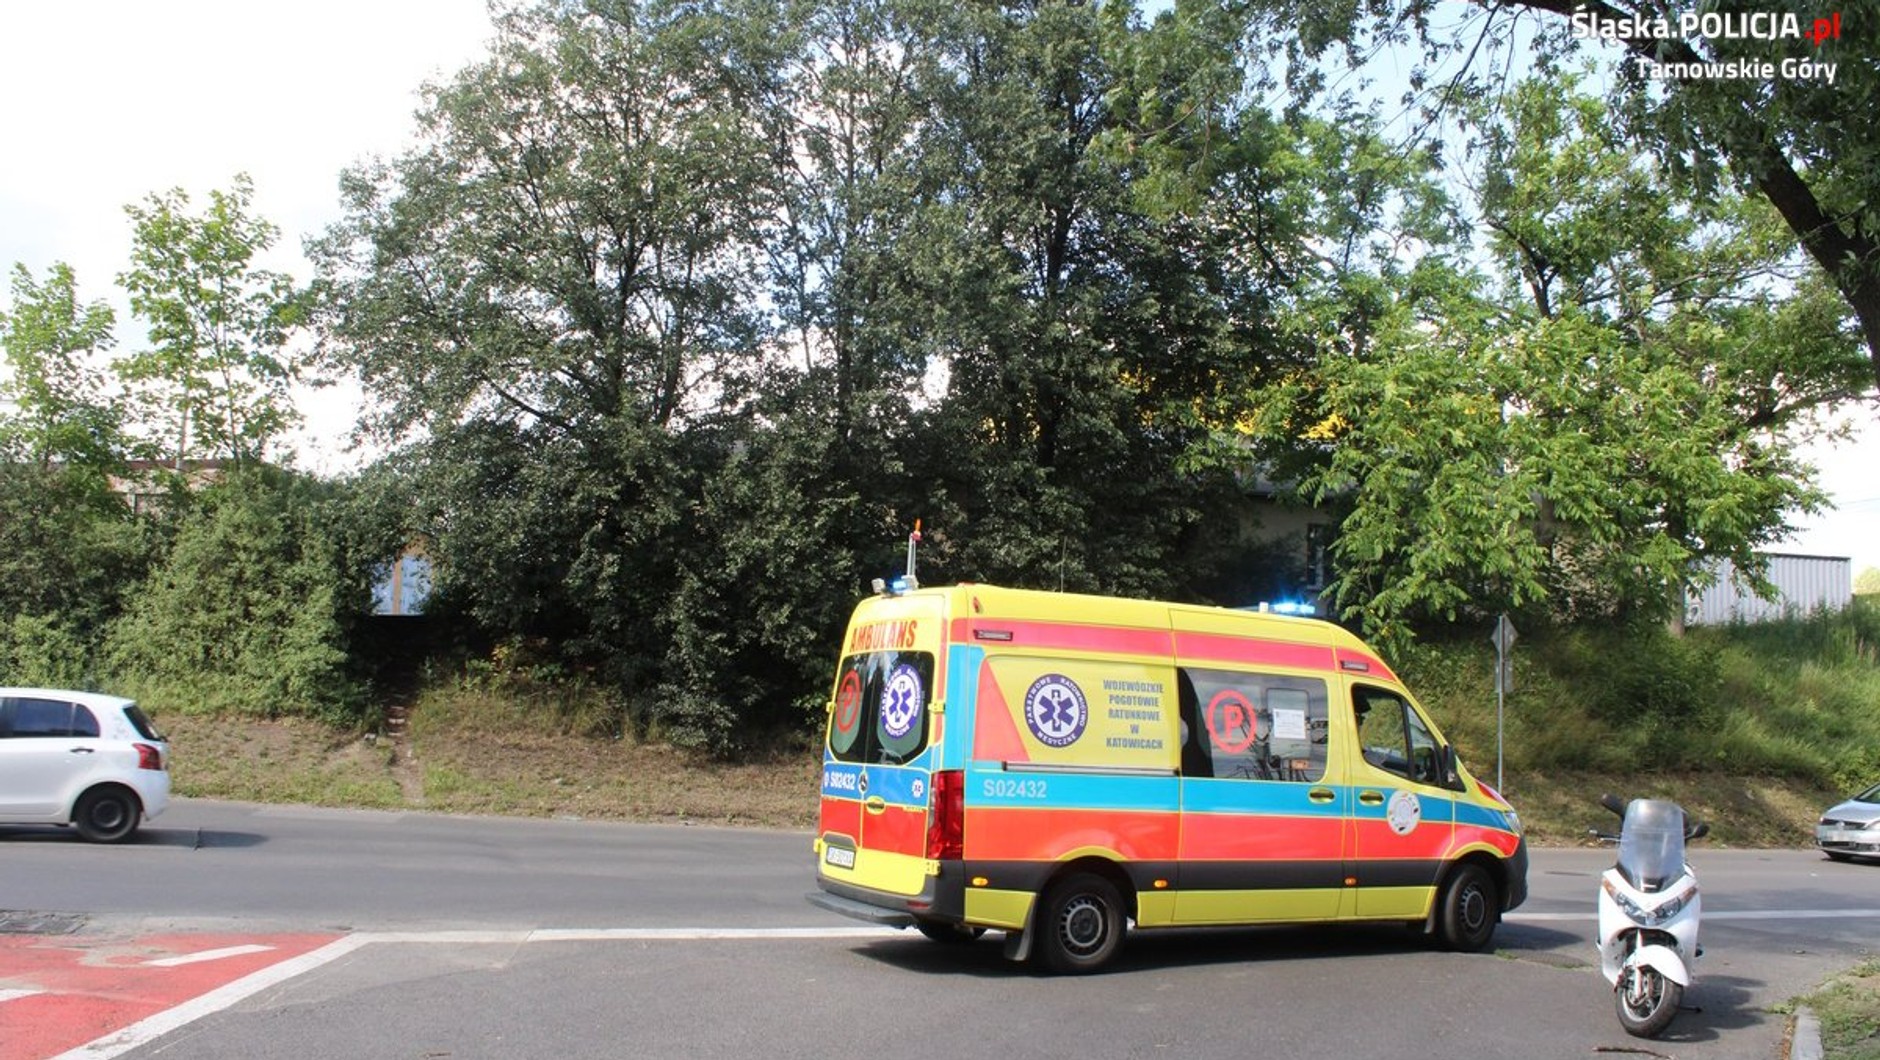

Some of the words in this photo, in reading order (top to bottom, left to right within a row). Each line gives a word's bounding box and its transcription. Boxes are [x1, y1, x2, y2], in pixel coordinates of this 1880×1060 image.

[850, 620, 917, 652] AMBULANS
[1109, 694, 1159, 707] POGOTOWIE
[1108, 708, 1160, 721] RATUNKOWE
[1130, 724, 1139, 734] W
[1106, 737, 1163, 749] KATOWICACH
[983, 779, 1047, 798] S02432
